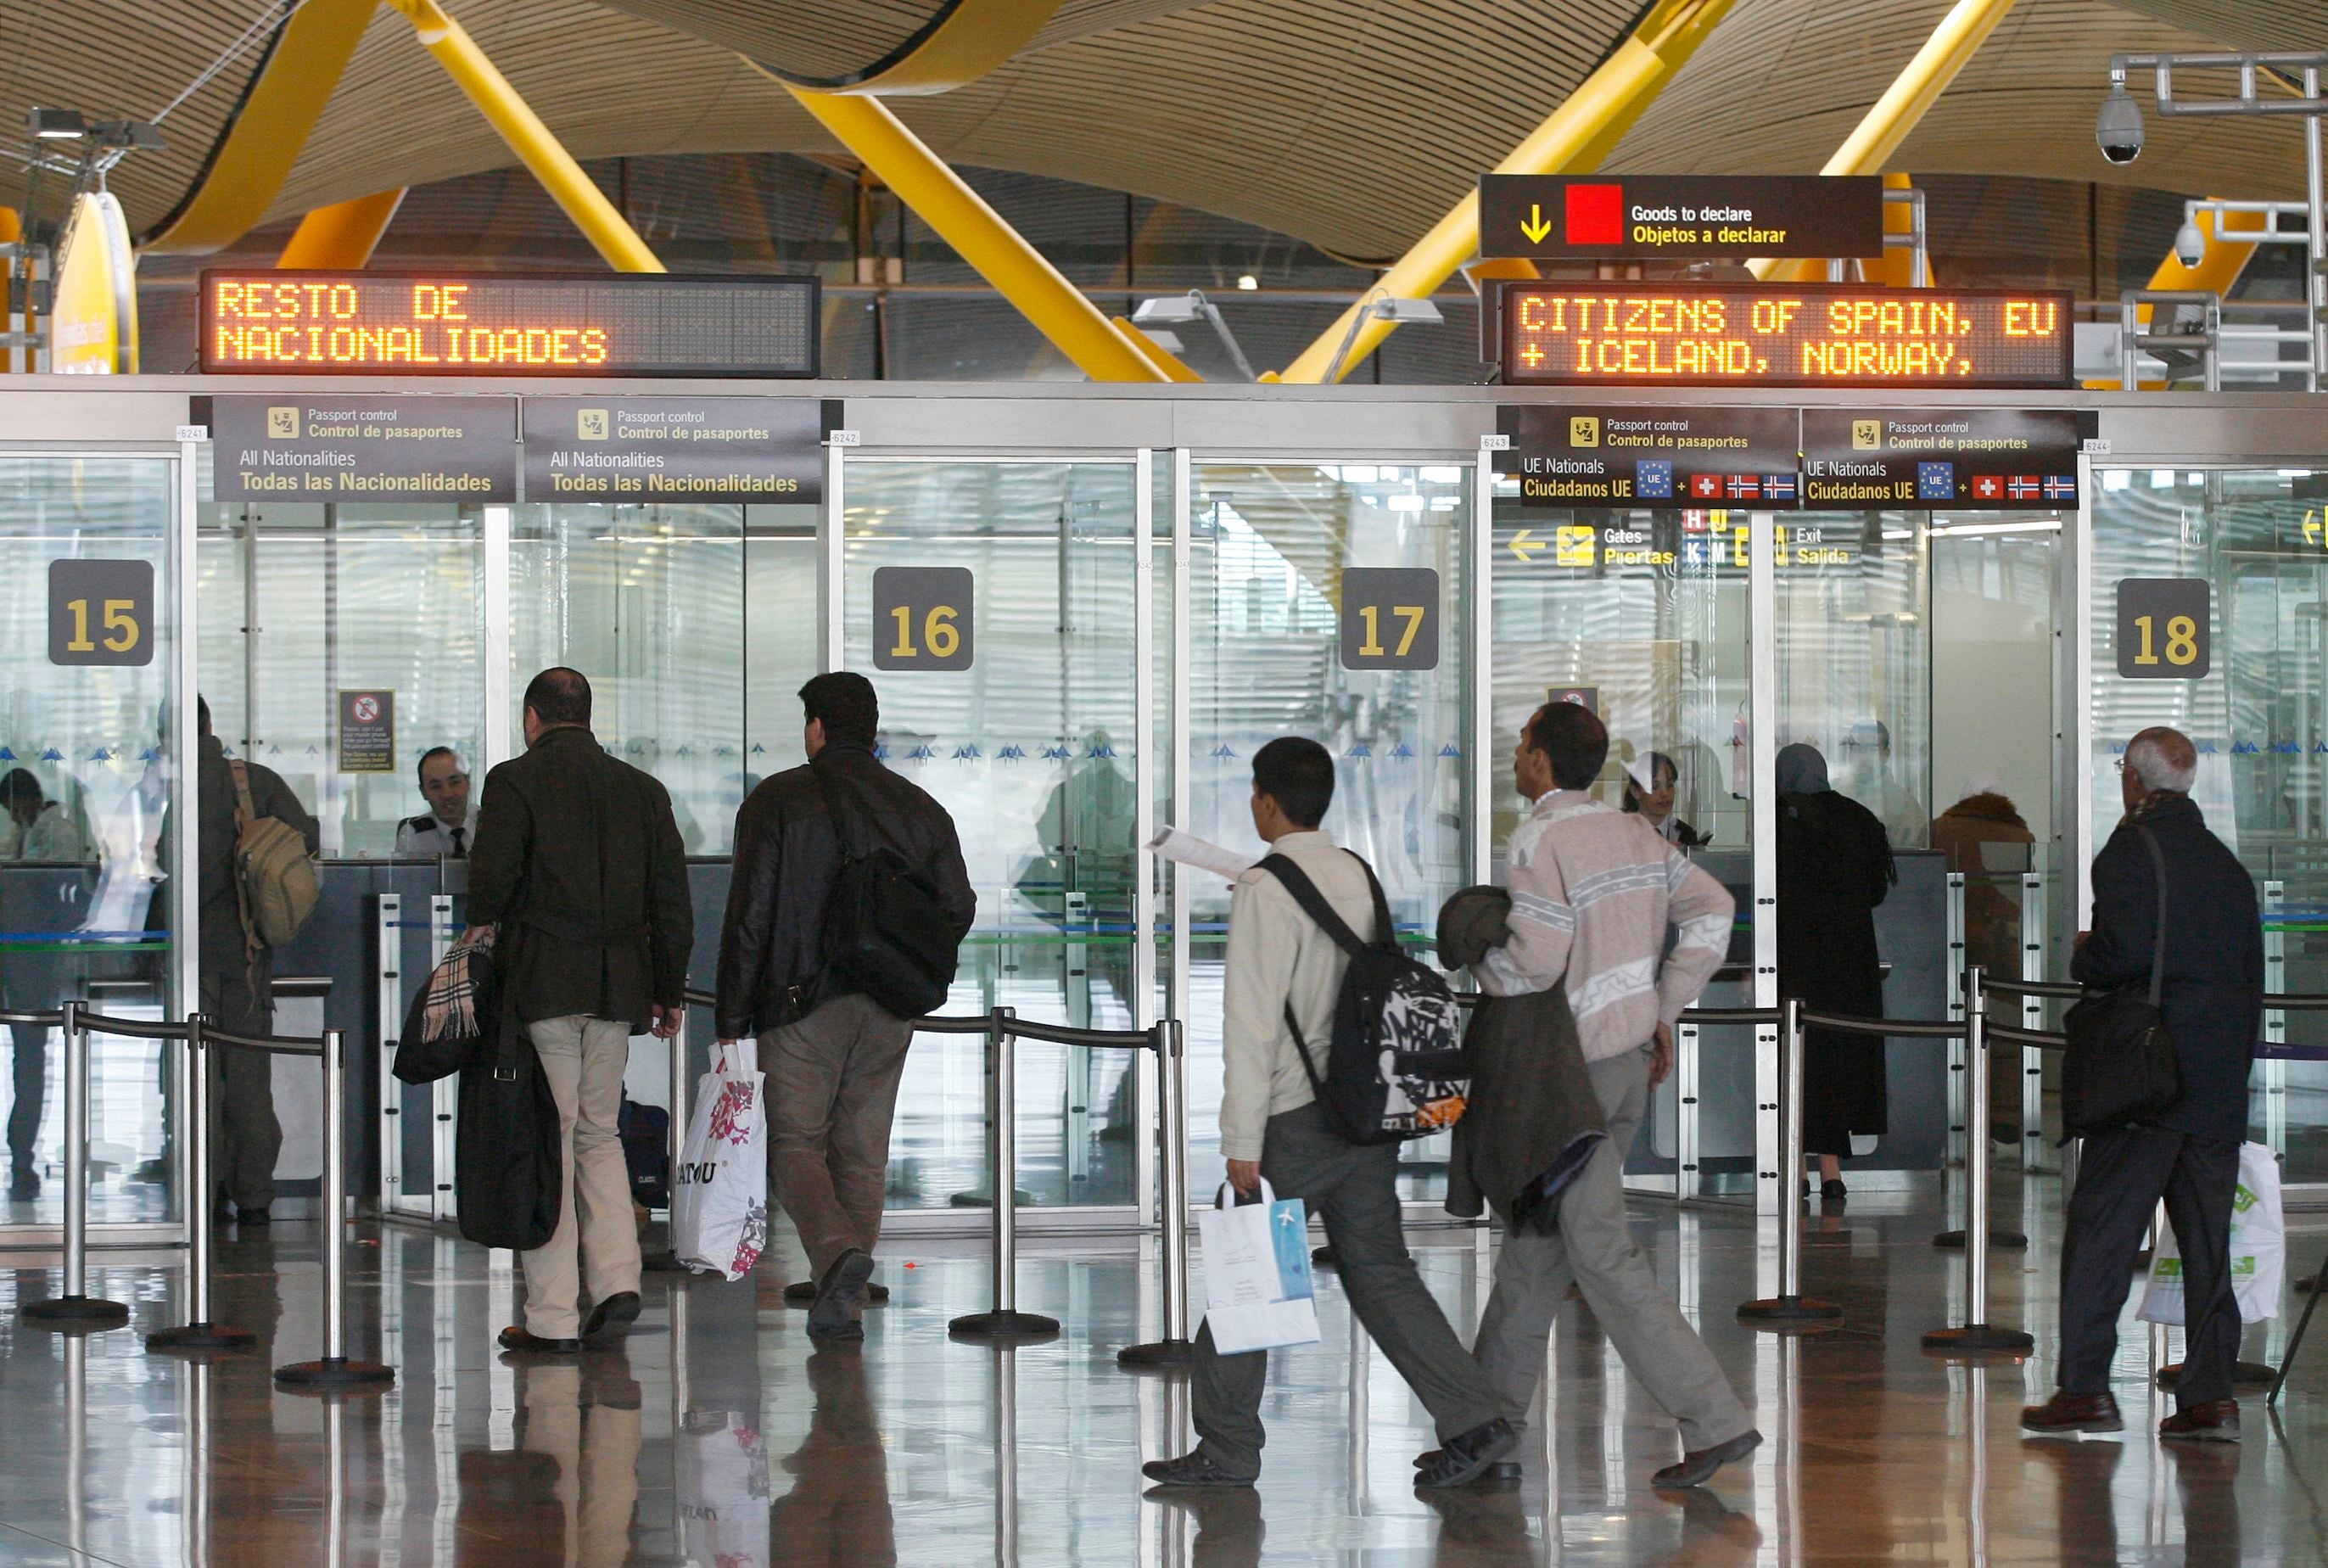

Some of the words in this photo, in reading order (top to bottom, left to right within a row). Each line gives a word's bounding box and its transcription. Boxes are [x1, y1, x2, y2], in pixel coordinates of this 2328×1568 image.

[1631, 205, 1677, 221] Goods
[1682, 206, 1696, 221] to
[1700, 206, 1753, 221] declare
[1632, 226, 1697, 246] Objetos
[1702, 230, 1712, 243] a
[1718, 226, 1786, 243] declarar
[217, 283, 358, 319] RESTO
[414, 284, 468, 320] DE
[1521, 297, 1725, 333] CITIZENS
[1753, 300, 1803, 333] OF
[1829, 301, 1972, 335] SPAIN,
[2006, 302, 2055, 335] EU
[217, 325, 607, 363] NACIONALIDADES
[1521, 343, 1544, 367] +
[1577, 339, 1767, 373] ICELAND,
[1802, 342, 1971, 375] NORWAY,
[308, 408, 356, 423] Passport
[360, 409, 397, 421] control
[618, 411, 666, 424] Passport
[669, 411, 705, 423] control
[180, 428, 203, 439] 6241
[308, 424, 360, 439] Control
[363, 425, 381, 439] de
[385, 426, 462, 440] pasaportes
[618, 426, 669, 440] Control
[672, 427, 689, 440] de
[693, 428, 769, 441] pasaportes
[1607, 418, 1652, 433] Passport
[1654, 420, 1688, 431] control
[1889, 422, 1933, 434] Passport
[1935, 423, 1968, 434] control
[833, 434, 857, 444] 6242
[1485, 437, 1506, 448] 6243
[1607, 434, 1654, 448] Control
[1657, 434, 1673, 448] de
[1677, 435, 1749, 450] pasaportes
[1889, 436, 1935, 450] Control
[1938, 437, 1954, 450] de
[1958, 438, 2028, 451] pasaportes
[2087, 442, 2107, 451] 6244
[239, 451, 258, 466] All
[263, 450, 356, 467] Nationalities
[550, 451, 568, 468] All
[573, 451, 664, 468] Nationalities
[1524, 458, 1542, 474] UE
[1546, 458, 1604, 474] Nationals
[1807, 461, 1824, 476] UE
[1829, 461, 1887, 477] Nationals
[239, 472, 299, 490] Todas
[305, 472, 333, 490] las
[339, 473, 492, 492] Nacionalidades
[550, 473, 608, 491] Todas
[614, 473, 642, 491] las
[648, 473, 797, 493] Nacionalidades
[1525, 479, 1608, 497] Ciudadanos
[1612, 479, 1631, 497] UE
[1647, 474, 1661, 484] UE
[1808, 481, 1891, 500] Ciudadanos
[1894, 482, 1914, 500] UE
[1929, 475, 1943, 485] UE
[1687, 509, 1701, 529] H
[1604, 528, 1642, 544] Gates
[1796, 528, 1822, 544] Exit
[1604, 547, 1674, 565] Puertas
[1687, 542, 1702, 563] K
[1712, 541, 1725, 563] M
[1797, 547, 1850, 565] Salida
[67, 599, 140, 652] 15
[890, 605, 960, 658] 16
[1358, 606, 1425, 656] 17
[2133, 615, 2197, 666] 18
[676, 1162, 716, 1184] ATOU
